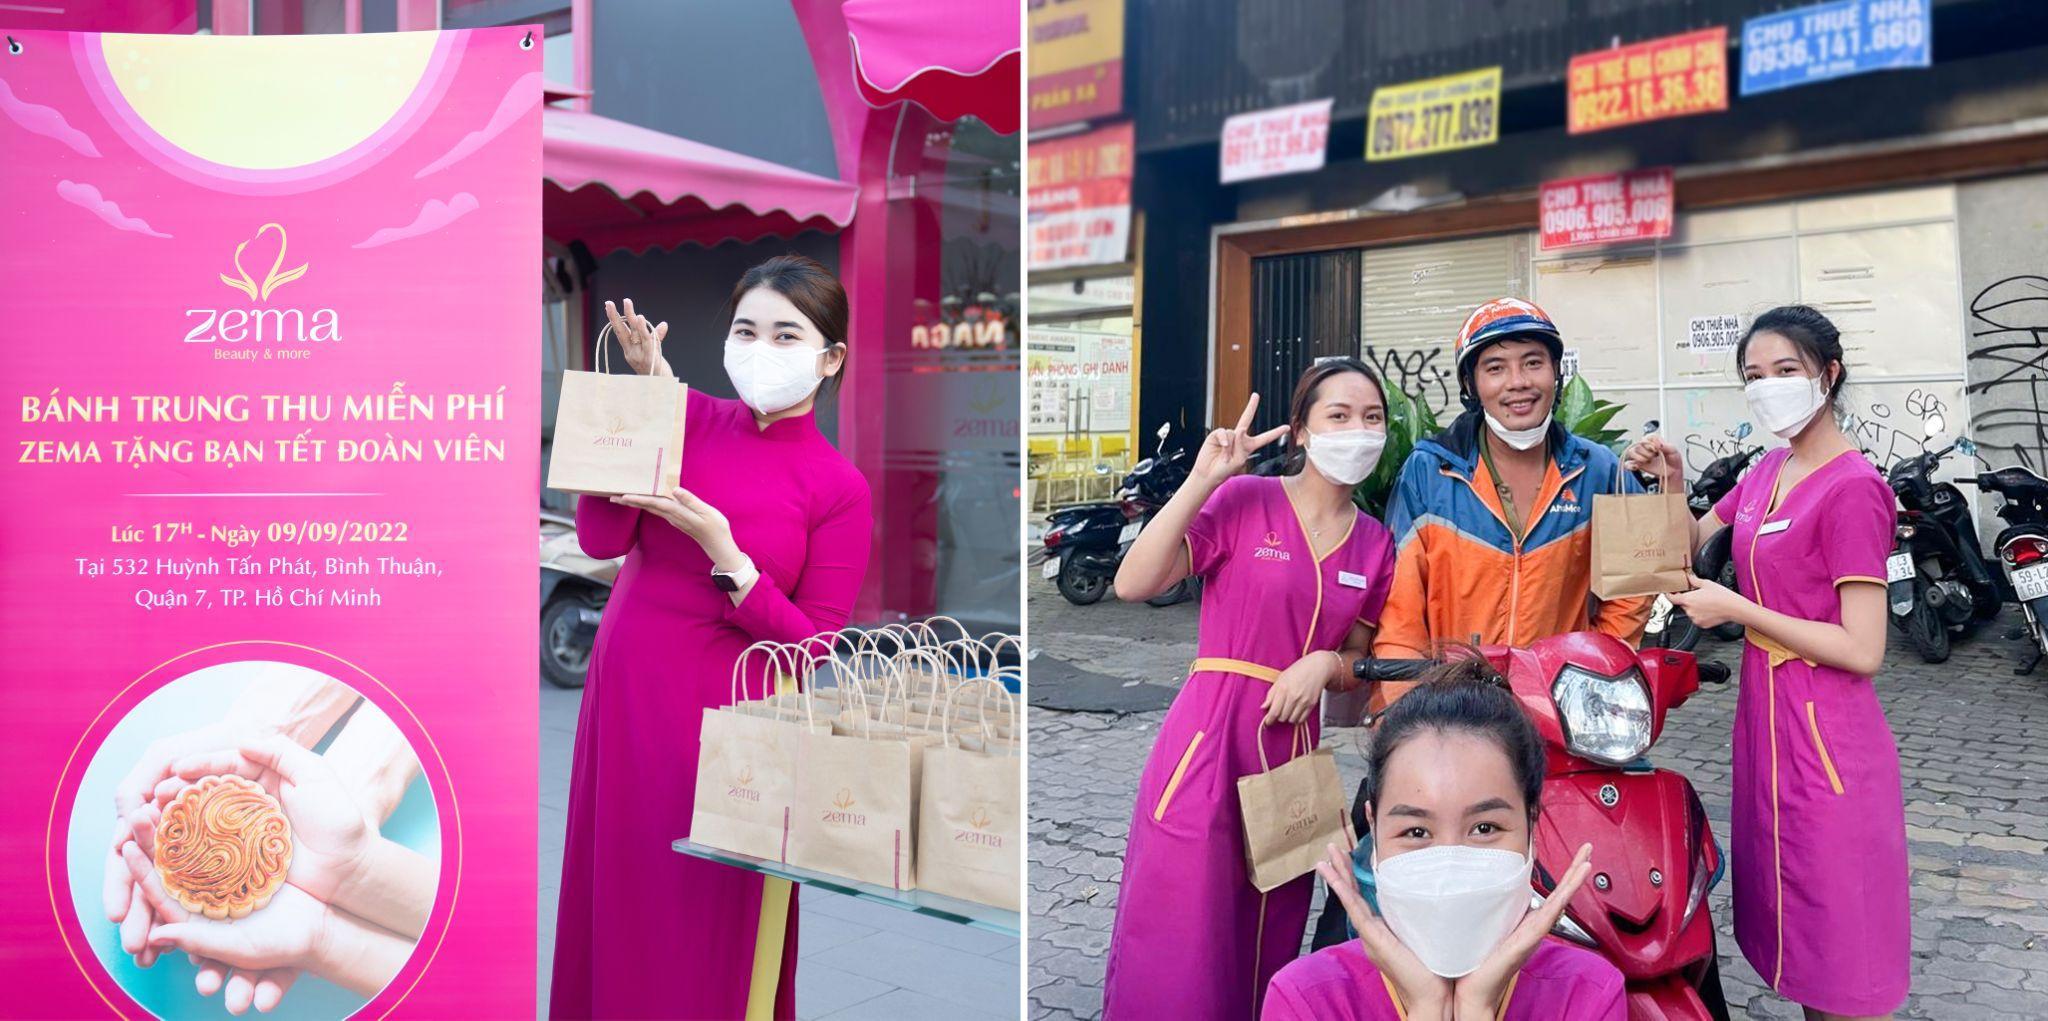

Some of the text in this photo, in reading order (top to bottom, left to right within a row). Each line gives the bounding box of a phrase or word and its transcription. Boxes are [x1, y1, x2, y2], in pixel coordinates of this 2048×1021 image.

[1748, 19, 1922, 76] 0936.141.660
[184, 307, 342, 343] zema
[1692, 320, 1706, 332] CHO
[214, 347, 311, 361] Beauty & more
[1102, 360, 1129, 375] DANH
[21, 380, 507, 423] BÁNH TRUNG THU MIỄN PHÍ
[18, 429, 506, 469] ZEMA TẶNG BẠN TẾT ĐOÀN VIÊN
[592, 436, 633, 448] zema
[111, 525, 144, 543] Lúc
[211, 525, 260, 547] Ngày
[267, 520, 409, 546] 09/09/2022
[1254, 547, 1291, 561] zema
[1633, 547, 1666, 558] zema
[75, 554, 443, 580] Tại 532 Huỳnh Tấn Phát, Bình Thuận,
[135, 586, 382, 612] Quận 7, TP. Hồ Chí Minh
[727, 784, 760, 802] zema
[822, 809, 866, 826] zema
[954, 829, 1003, 848] zema
